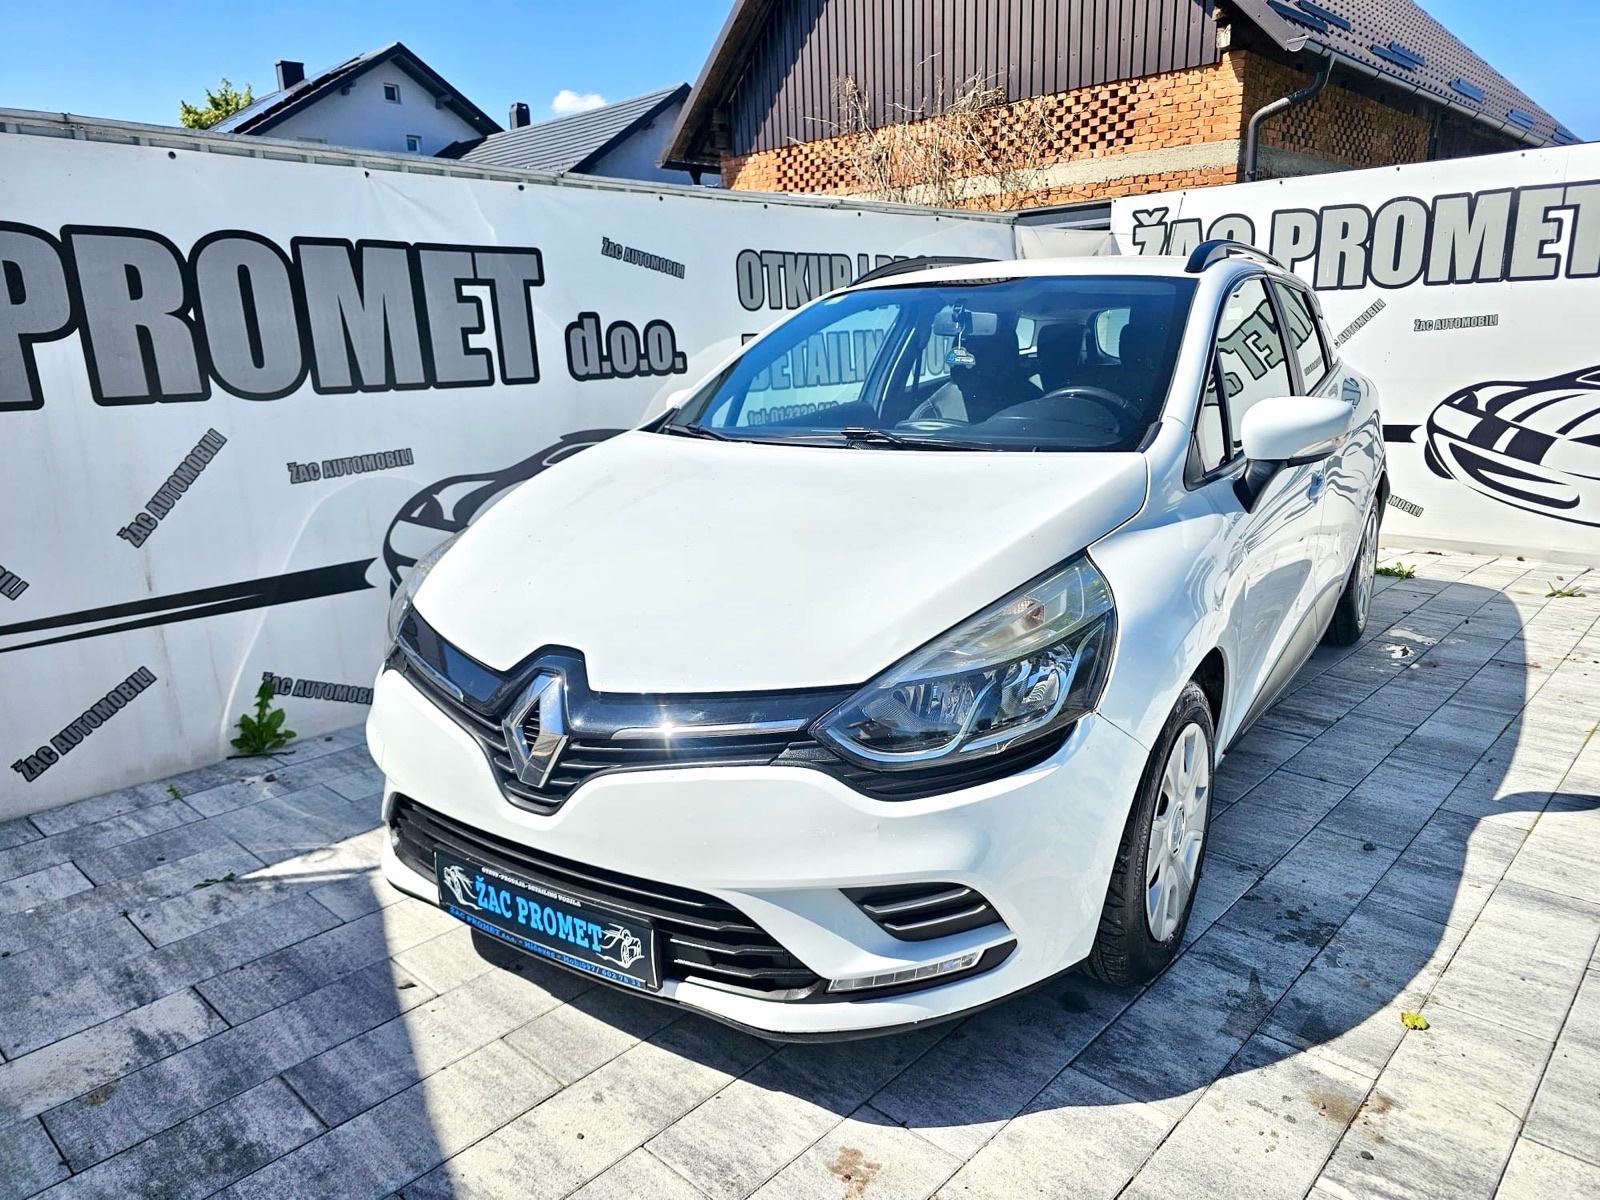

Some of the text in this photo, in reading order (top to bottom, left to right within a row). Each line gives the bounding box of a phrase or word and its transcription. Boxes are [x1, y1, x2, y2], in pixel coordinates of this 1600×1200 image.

[601, 237, 686, 280] ŽAC AUTOMOBILI
[1271, 181, 1600, 290] PROMET
[0, 221, 545, 411] PROMET
[565, 312, 688, 382] d.o.o.
[1337, 298, 1387, 345] AUTOMOBILI
[1414, 314, 1499, 332] ŽAC AUTOMOBILI
[117, 428, 228, 549] ŽAC AUTOMOBILI
[287, 448, 414, 484] ŽAC AUTOMOBILI
[262, 671, 375, 706] AC AUTOMOBI
[11, 666, 158, 782] ŽAC AUTOMOBILI
[475, 875, 602, 953] ŽAC PROMET
